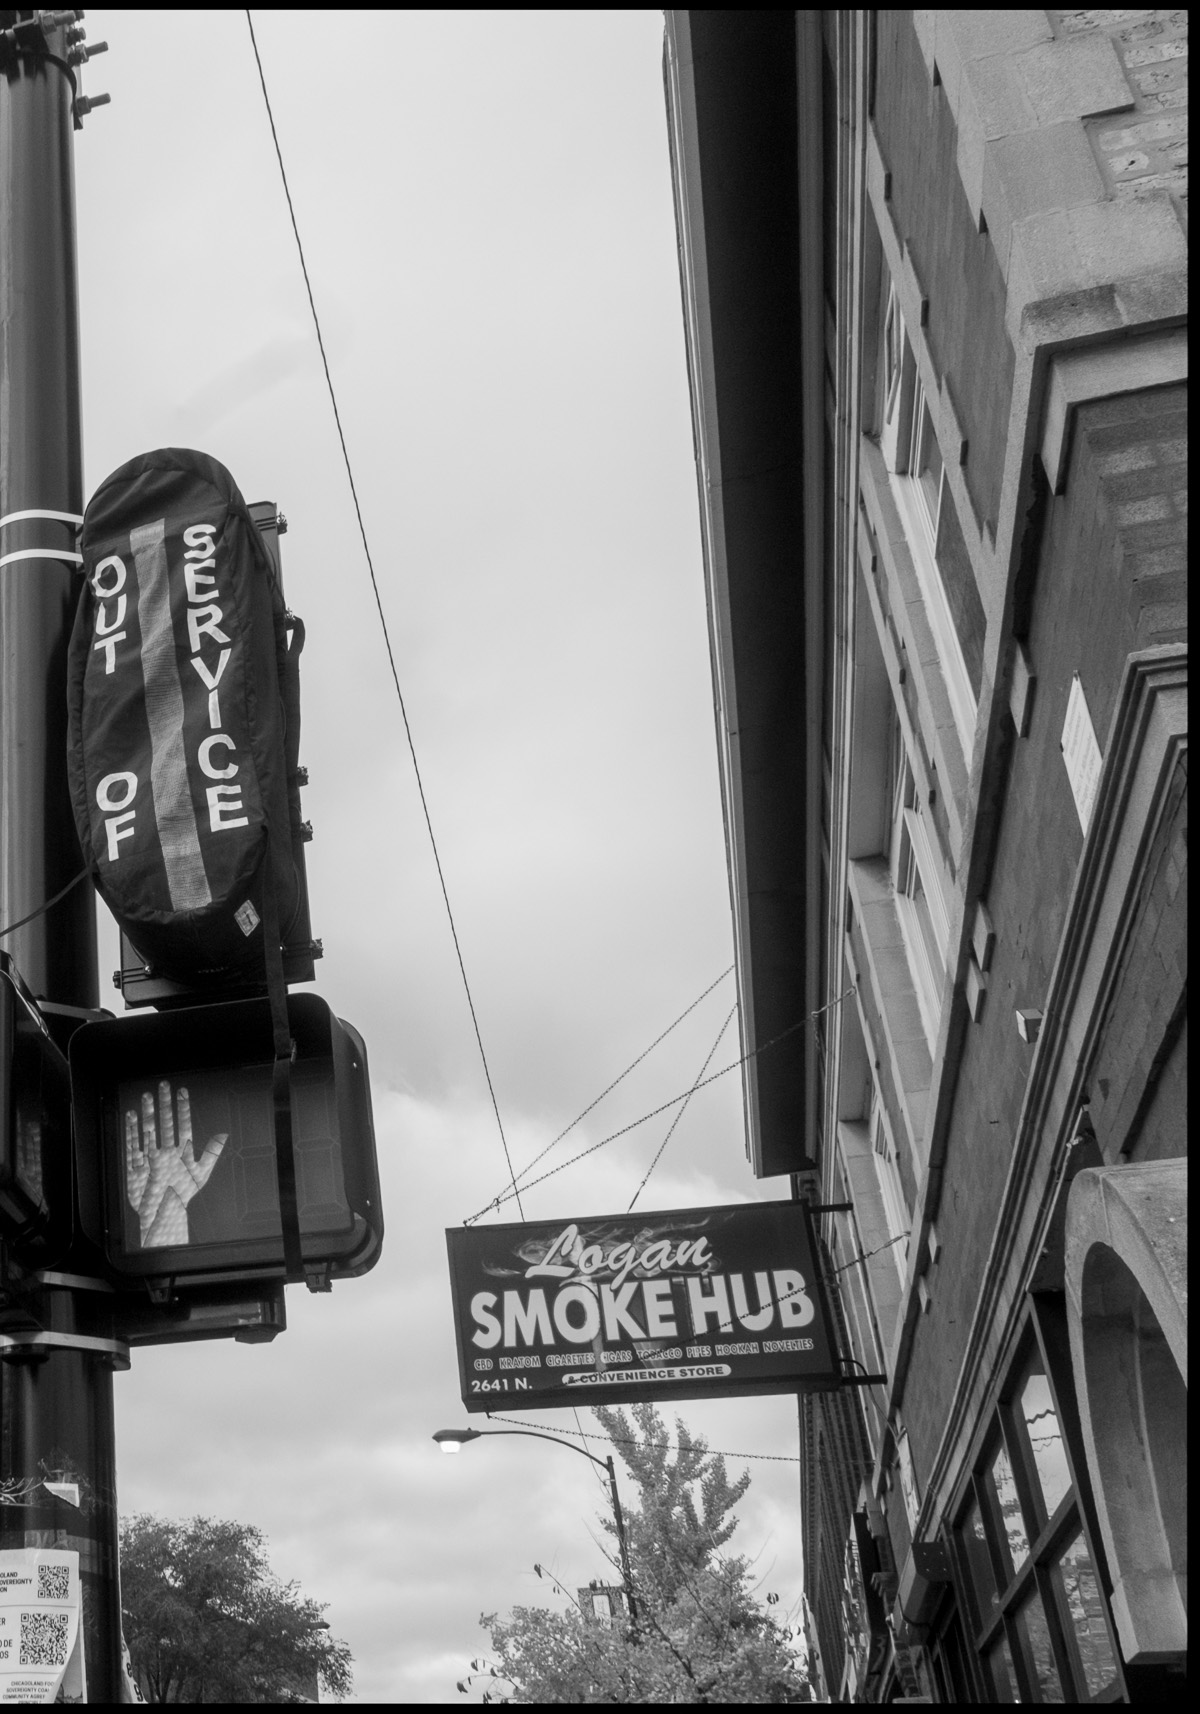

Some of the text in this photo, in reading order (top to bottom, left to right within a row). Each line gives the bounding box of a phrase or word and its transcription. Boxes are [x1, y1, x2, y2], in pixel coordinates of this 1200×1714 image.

[183, 523, 249, 833] SERVICE
[92, 555, 138, 862] OUT OF
[524, 1223, 713, 1290] Logan
[470, 1269, 815, 1349] SMOKE HUB
[474, 1338, 814, 1371] CBD KRATOM CIGARETTES CIGARS TOBACCO PIPES HOOKAH NOVELTIES
[580, 1369, 675, 1384] CONVENIENCE
[679, 1366, 724, 1378] STORE
[471, 1377, 533, 1392] 2641 N.
[4, 1639, 12, 1648] DE
